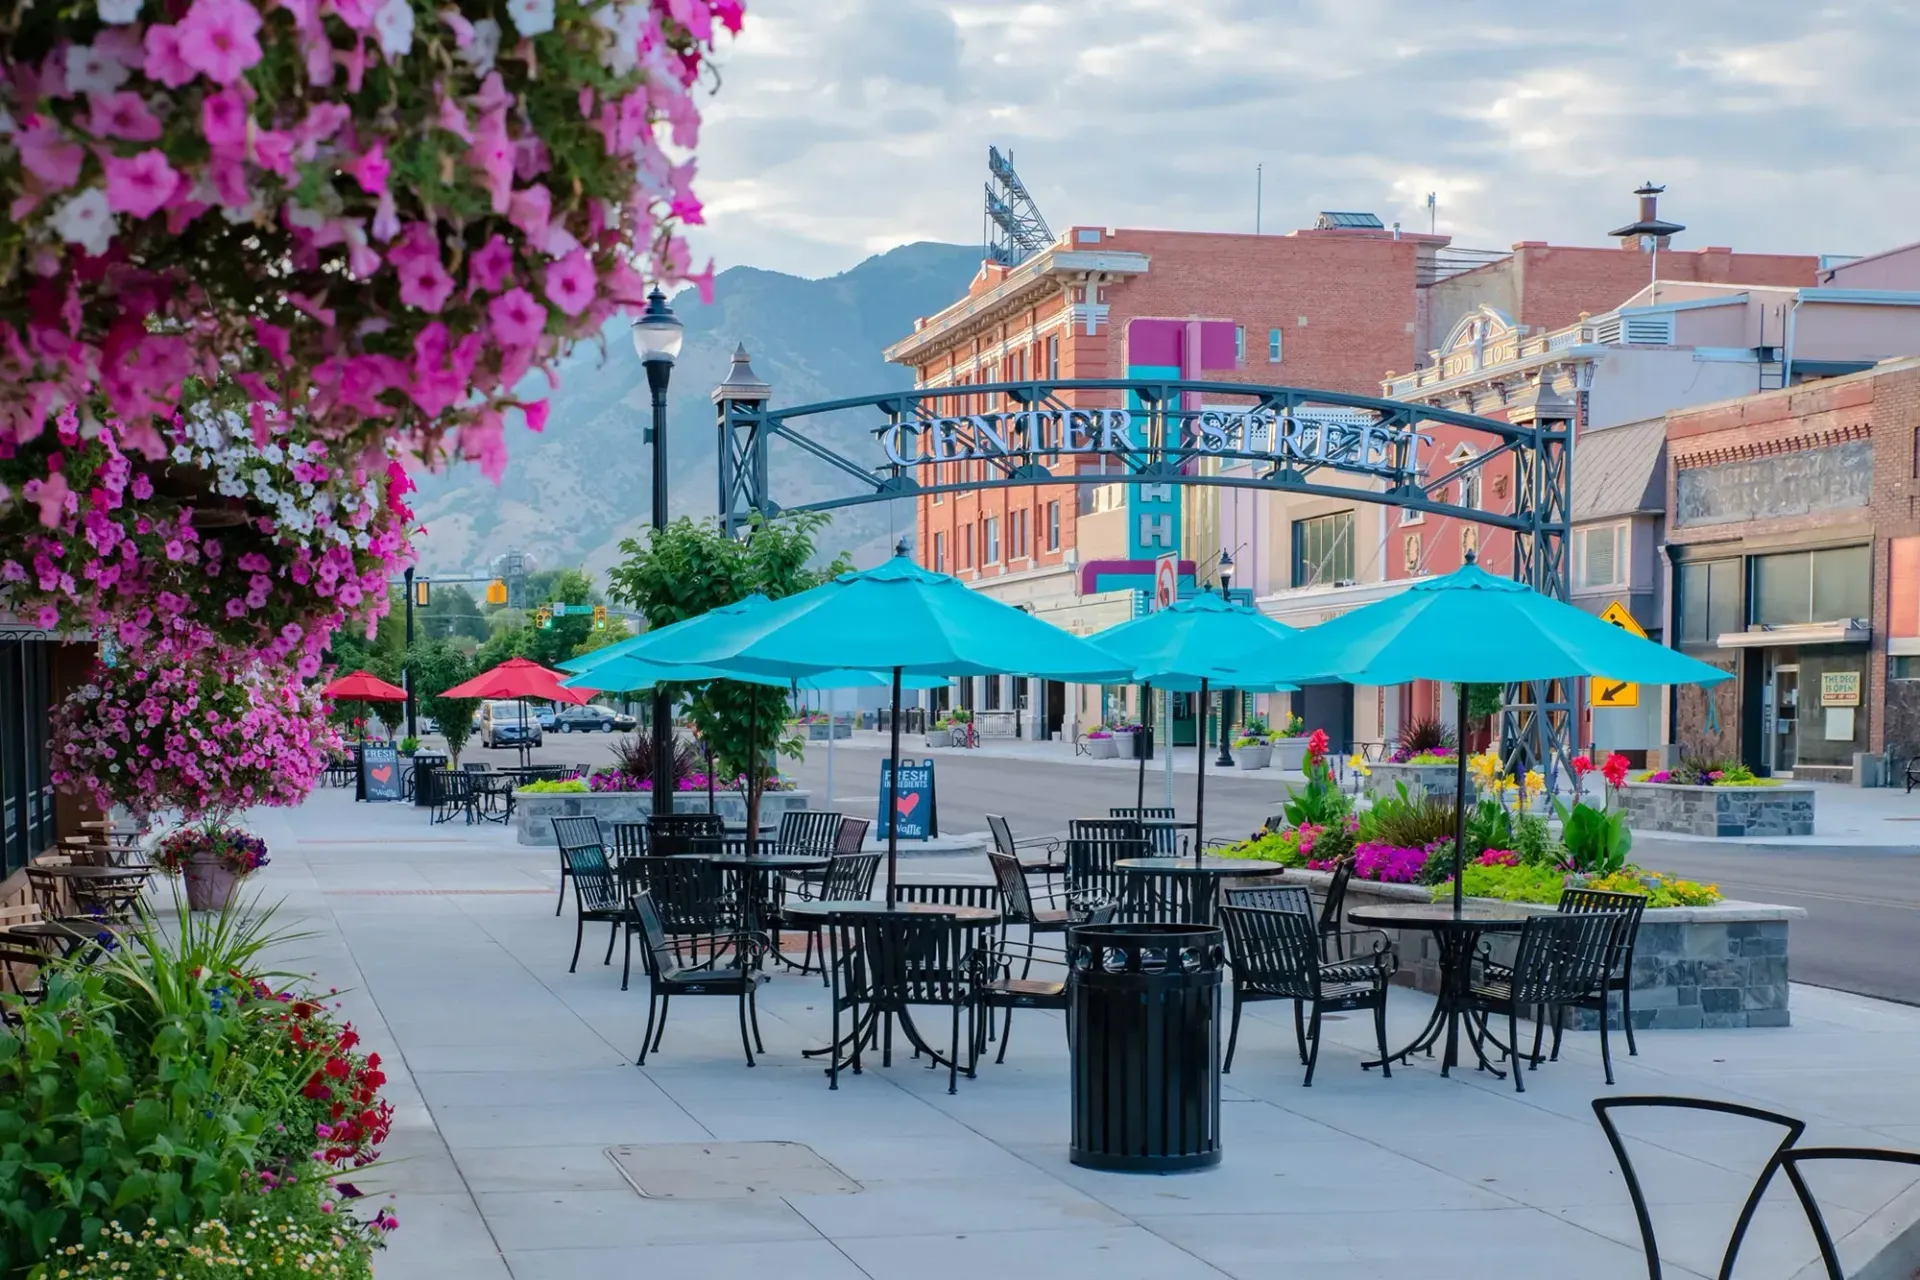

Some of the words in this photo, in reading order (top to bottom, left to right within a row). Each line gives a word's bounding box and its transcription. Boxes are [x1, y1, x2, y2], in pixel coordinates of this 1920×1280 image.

[883, 408, 1138, 468] CENTER
[1198, 410, 1434, 476] STREET
[1824, 675, 1839, 684] THE
[364, 749, 396, 758] FRESH
[884, 780, 928, 788] INREDIENTS
